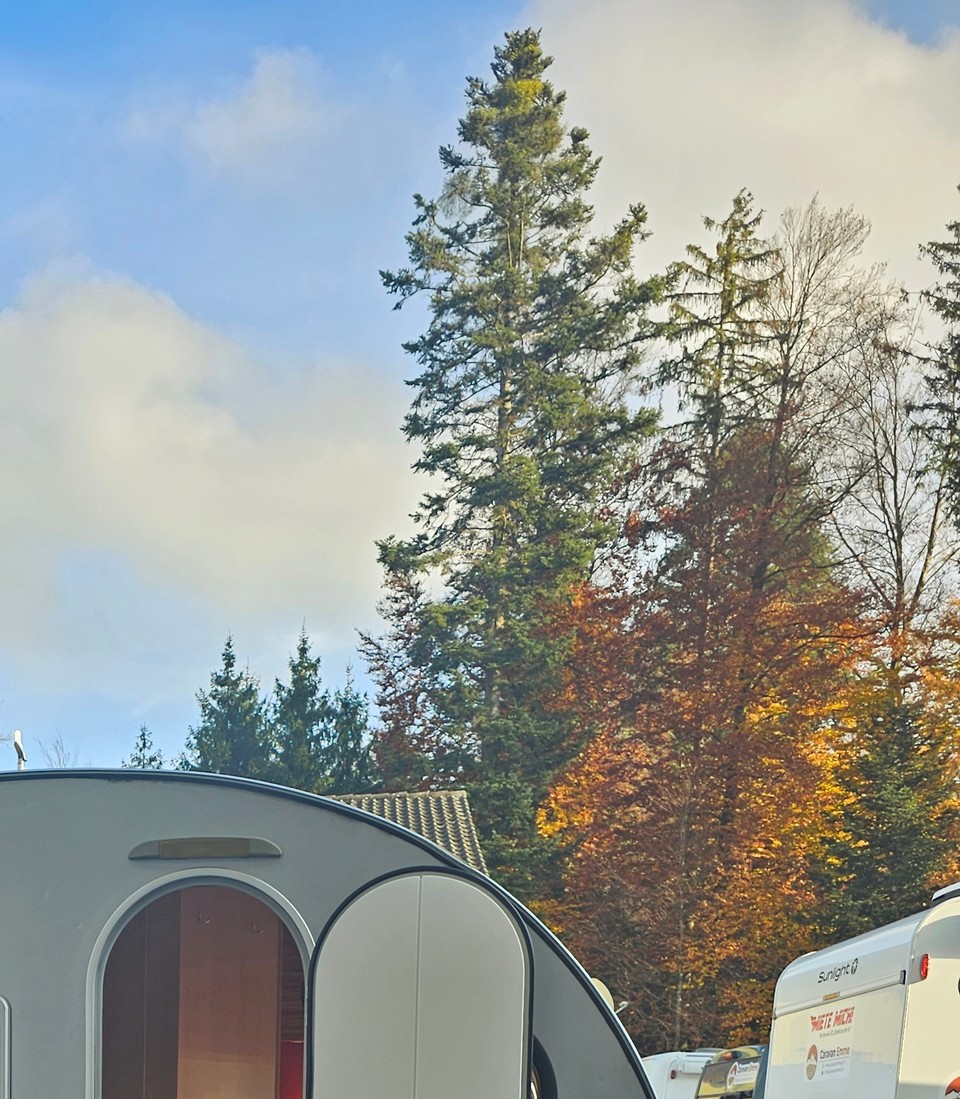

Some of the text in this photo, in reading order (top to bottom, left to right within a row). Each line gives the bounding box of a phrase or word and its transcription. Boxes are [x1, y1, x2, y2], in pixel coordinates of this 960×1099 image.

[818, 964, 850, 983] Sunlight
[810, 1011, 834, 1032] MIETE
[820, 1046, 851, 1060] Caravan Emme
